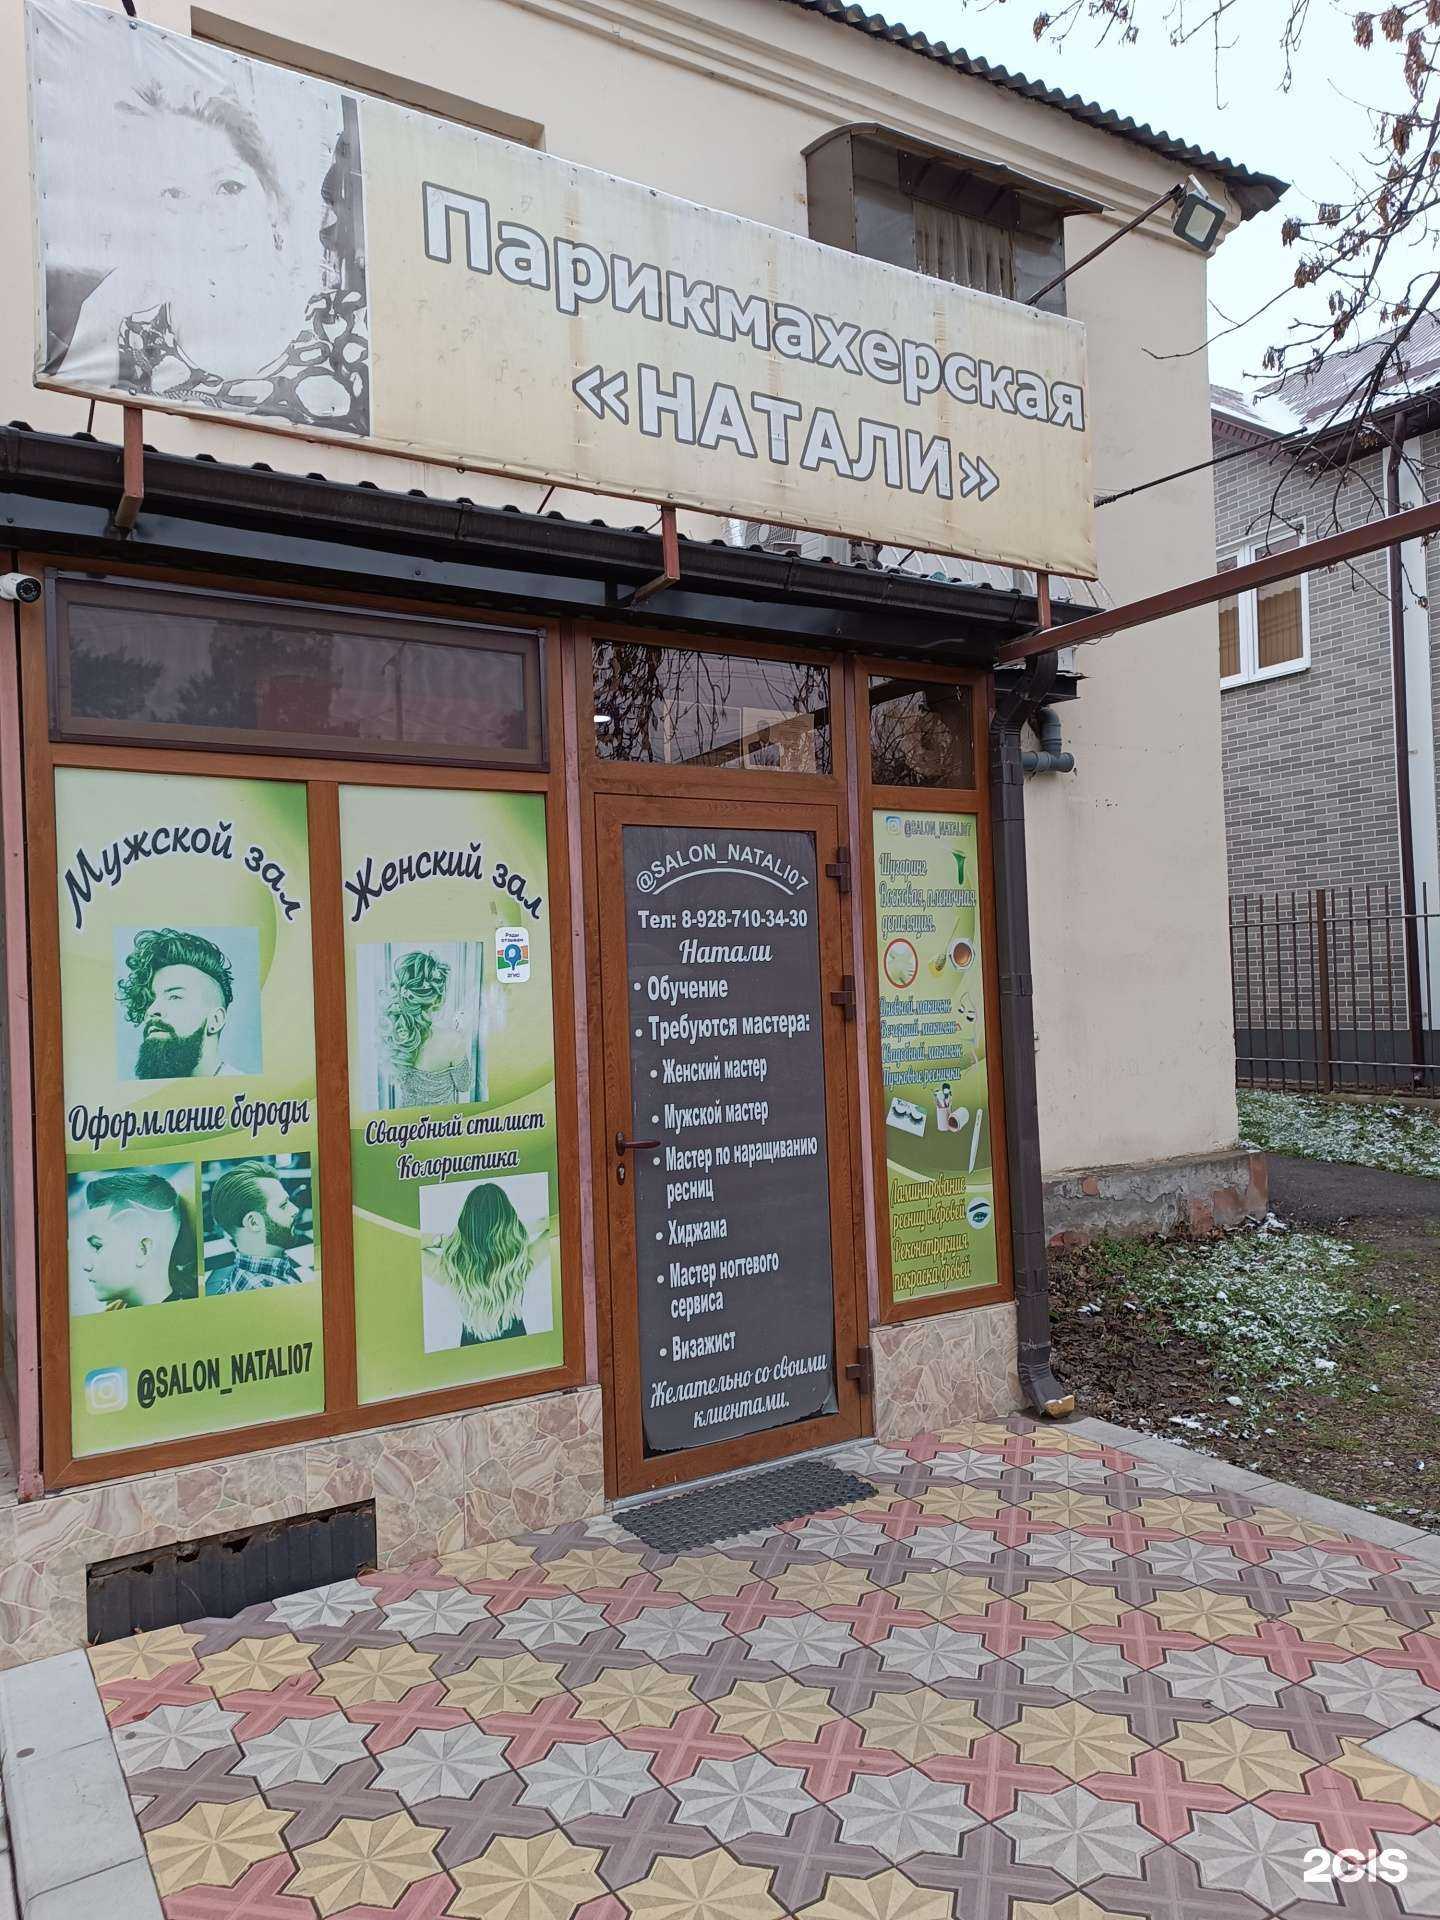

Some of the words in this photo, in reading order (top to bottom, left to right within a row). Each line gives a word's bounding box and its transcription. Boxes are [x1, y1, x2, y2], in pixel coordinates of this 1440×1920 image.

[422, 181, 1086, 431] Парикмахерская
[572, 363, 1000, 500] «НАТАЛИ»
[64, 821, 233, 929] Мужской
[244, 845, 302, 922] зал
[344, 843, 483, 923] Женский
[492, 862, 543, 920] зал
[636, 843, 809, 893] @SALON_NATALI07
[637, 910, 677, 929] Тел:
[682, 909, 808, 928] 8-928-710-34-30
[678, 939, 773, 964] Натали
[647, 974, 729, 1006] Обучение
[648, 1013, 738, 1046] Требуются
[742, 1013, 811, 1039] мастера:
[662, 1055, 720, 1084] Женский
[724, 1057, 767, 1082] мастер
[69, 1104, 226, 1151] Оформление
[231, 1093, 311, 1138] бороды
[365, 1114, 463, 1148] Свадебный
[466, 1113, 546, 1136] стилист
[664, 1099, 722, 1135] Мужской
[725, 1101, 769, 1126] мастер
[398, 1150, 519, 1181] Колористика
[665, 1144, 713, 1173] Мастер
[716, 1149, 731, 1167] по
[733, 1136, 818, 1169] наращиванию
[666, 1178, 714, 1210] ресниц
[891, 1172, 967, 1207] Ламинирование
[668, 1217, 728, 1247] Хиджама
[892, 1210, 926, 1238] ресниц
[926, 1208, 934, 1225] и
[934, 1198, 966, 1230] бровей
[669, 1262, 717, 1288] Мастер
[720, 1252, 780, 1281] ногтевого
[893, 1266, 939, 1297] покраска
[671, 1291, 724, 1321] сервиса
[672, 1331, 737, 1362] Визажист
[137, 1342, 313, 1409] @SALON_NATALI07
[650, 1370, 752, 1409] Желательно
[755, 1366, 773, 1385] со
[773, 1353, 828, 1380] своими
[693, 1391, 790, 1429] клиентами.
